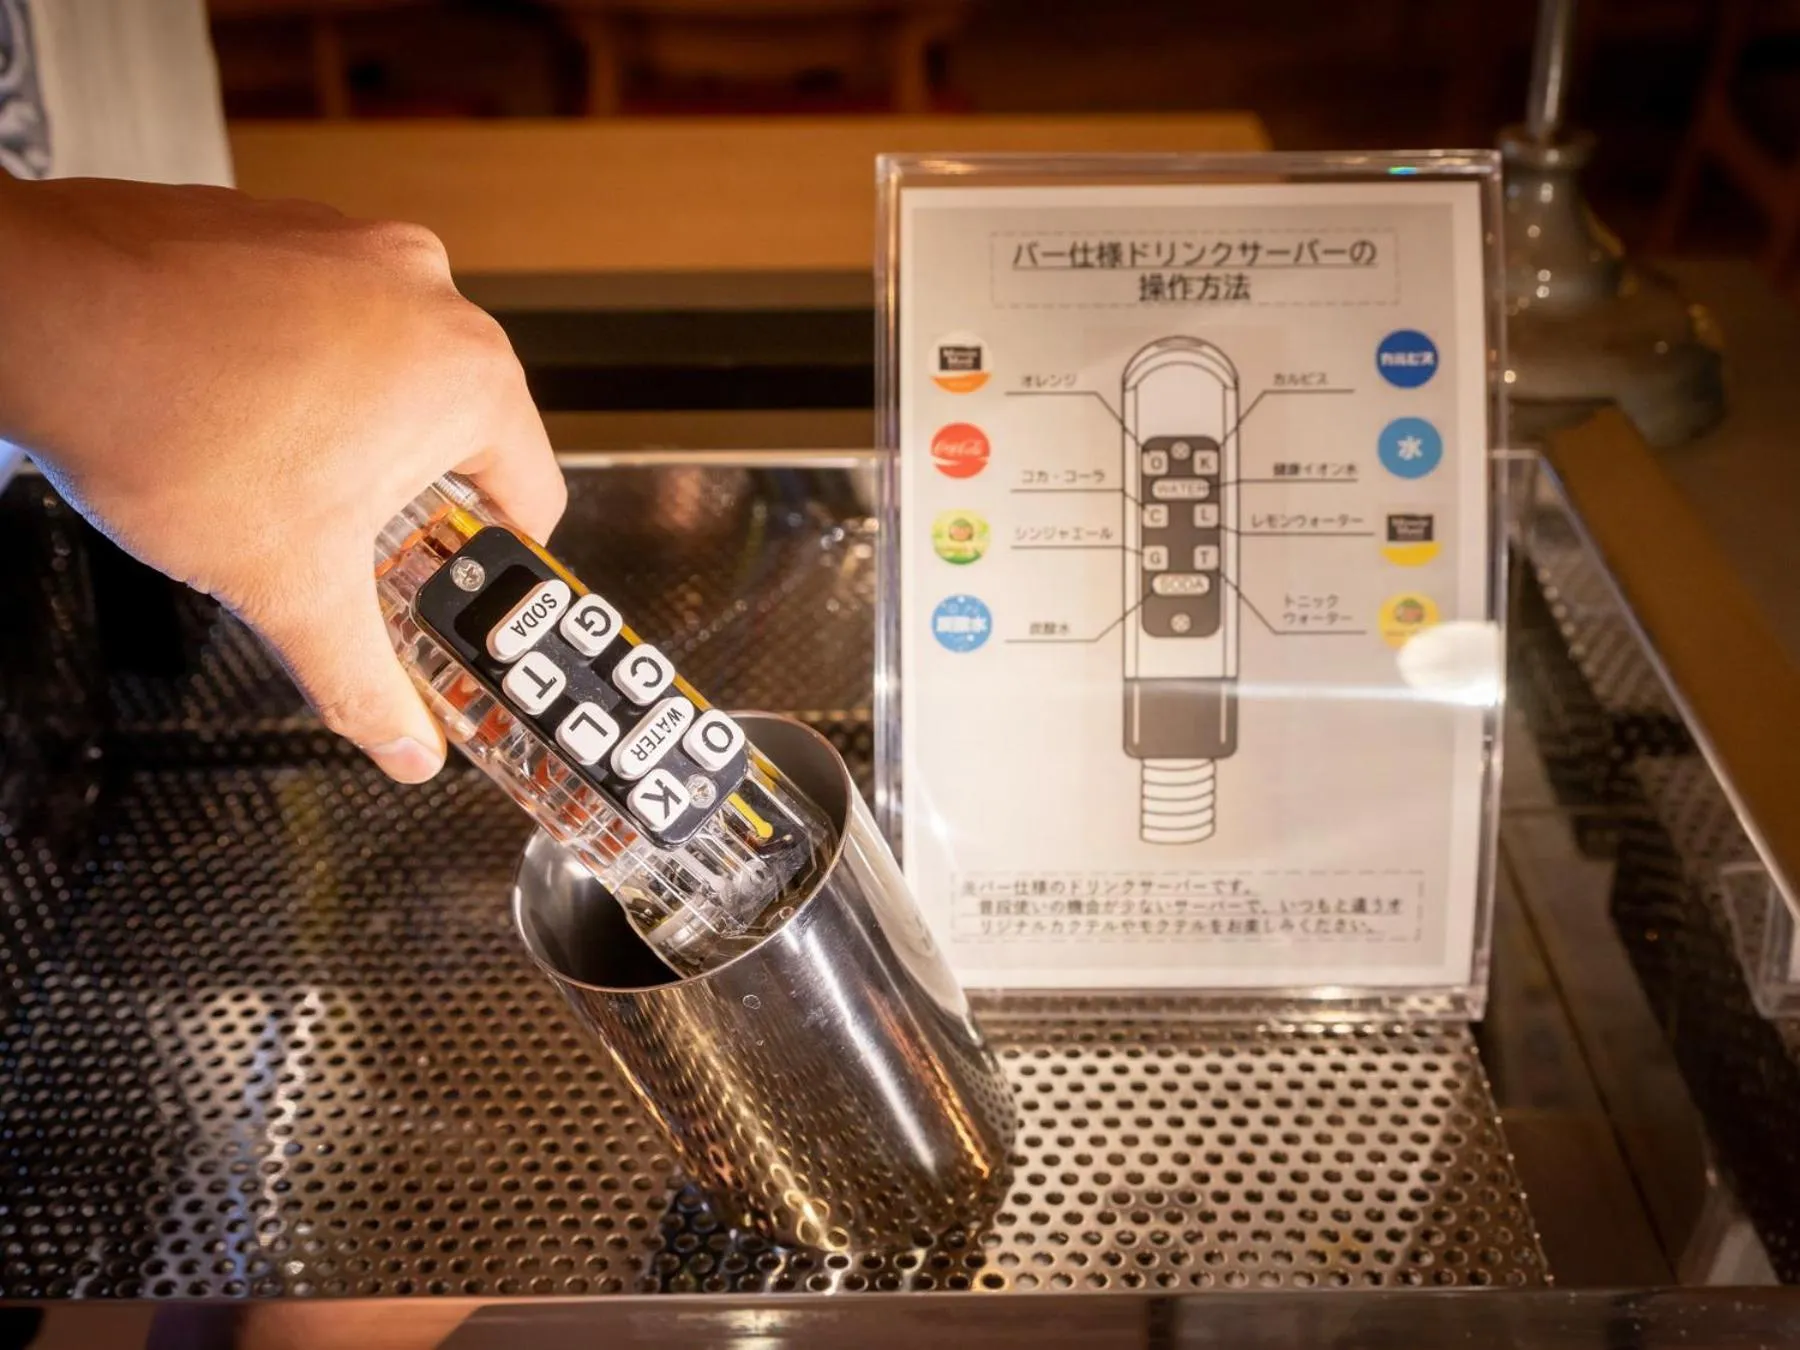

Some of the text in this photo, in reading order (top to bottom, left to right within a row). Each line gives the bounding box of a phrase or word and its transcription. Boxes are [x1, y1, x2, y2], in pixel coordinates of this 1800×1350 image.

[1012, 239, 1377, 268] バー仕様ドリンクサーバーの
[1138, 273, 1251, 301] 操作方法
[1021, 374, 1077, 388] オレンジ
[1021, 469, 1105, 484] コカ・コーラ
[1199, 456, 1212, 470] K
[1150, 509, 1163, 523] C
[1201, 508, 1211, 522] L
[1200, 551, 1210, 564] T
[509, 592, 558, 638] SODA
[574, 605, 612, 638] G
[522, 665, 557, 700] T
[630, 655, 664, 689] C
[568, 711, 609, 740] L
[632, 706, 684, 762] WATER
[701, 720, 734, 754] O
[641, 777, 683, 820] K
